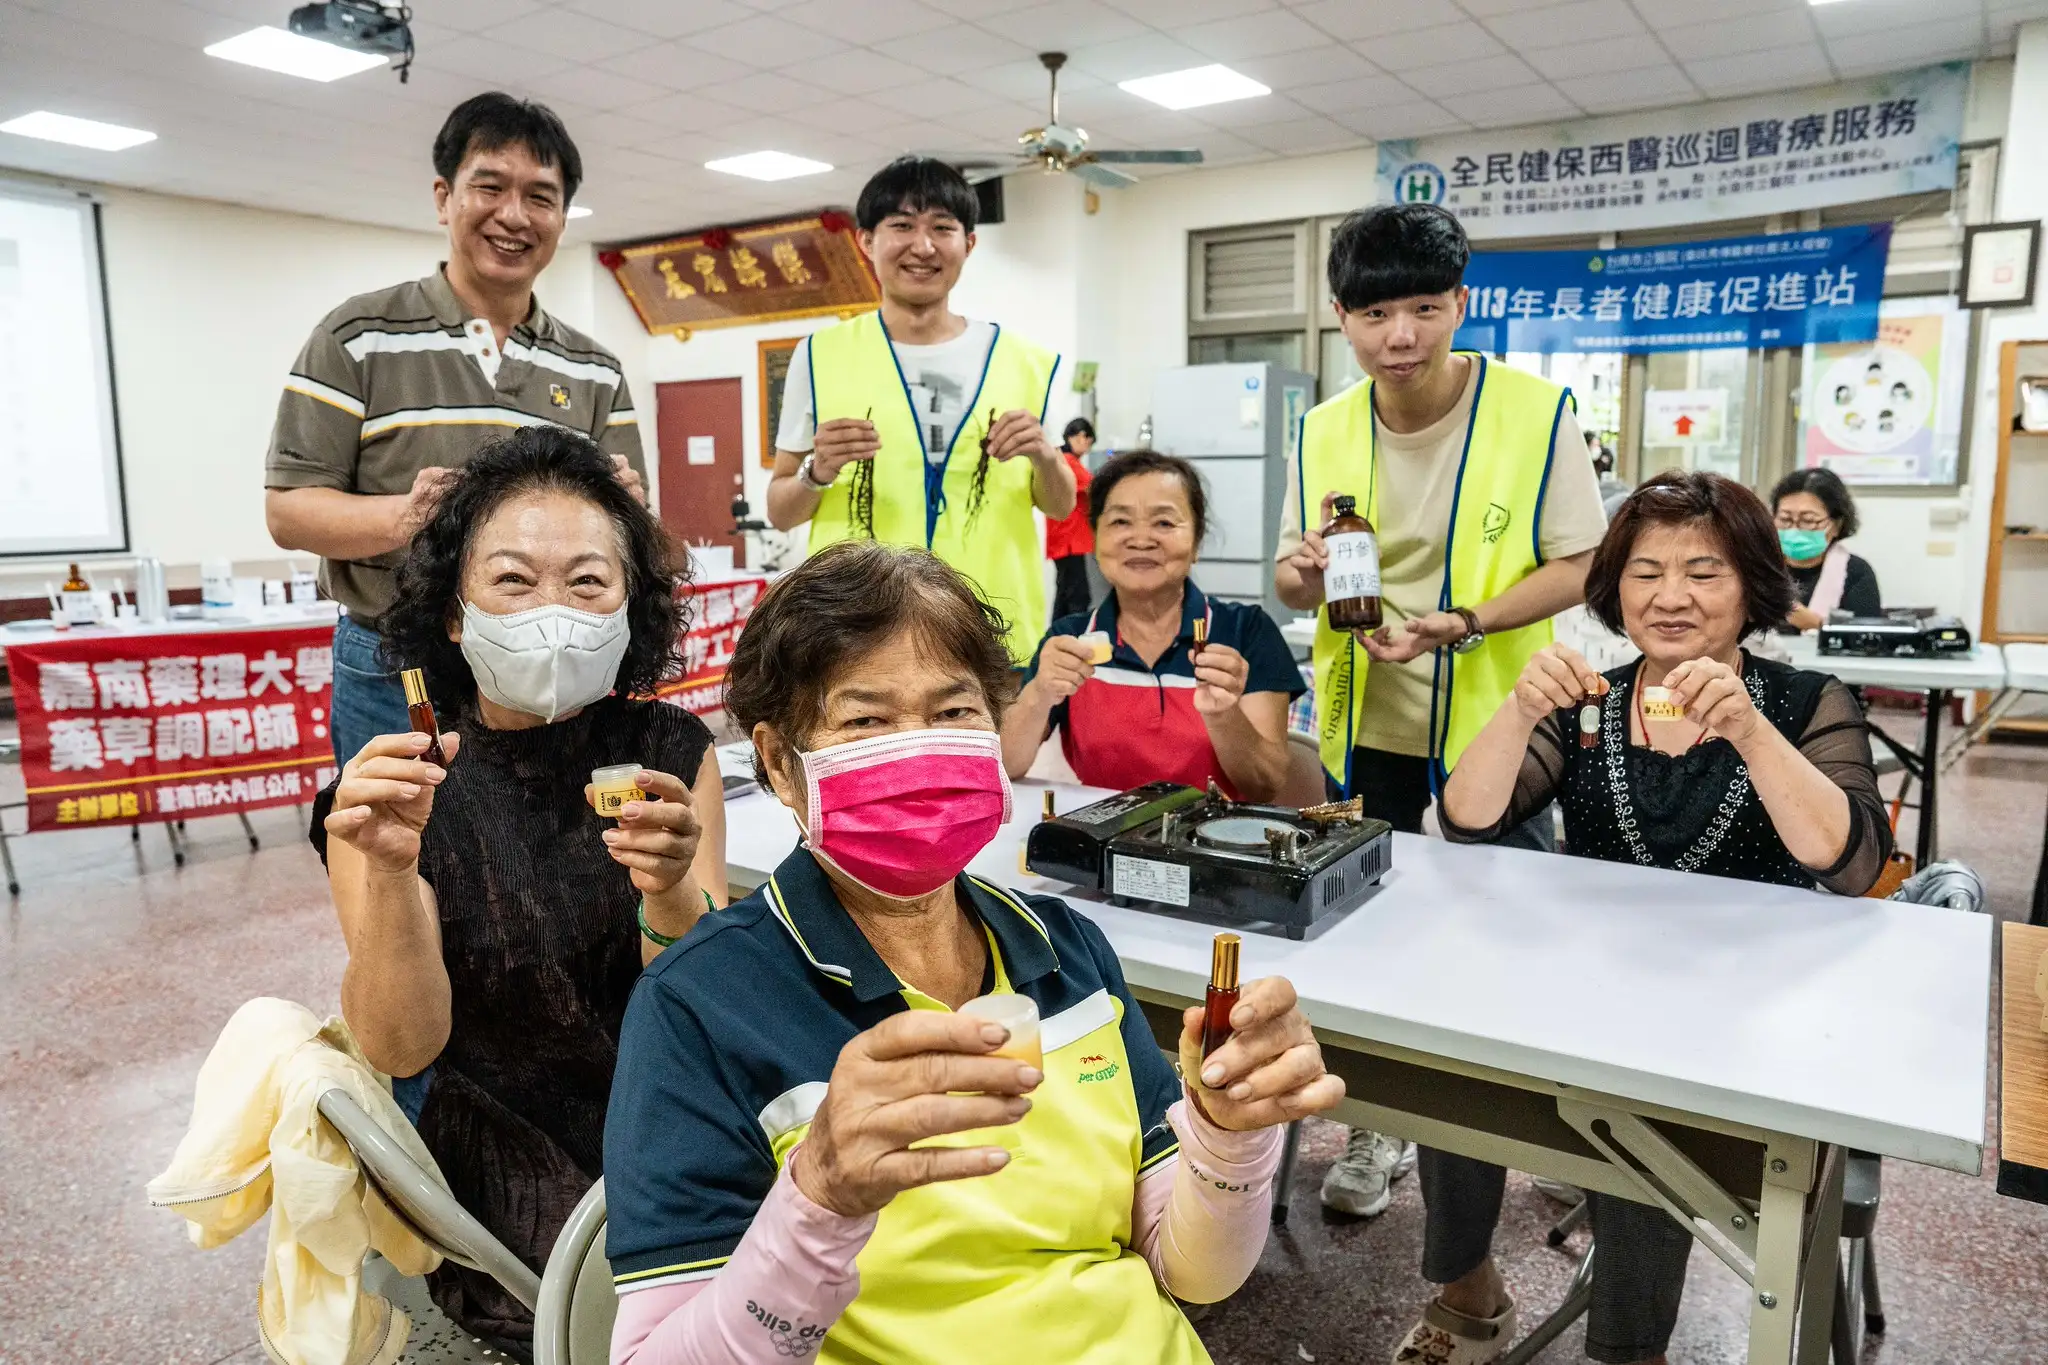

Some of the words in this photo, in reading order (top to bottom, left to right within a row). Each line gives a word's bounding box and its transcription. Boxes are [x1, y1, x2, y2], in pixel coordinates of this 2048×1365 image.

[1450, 98, 1918, 188] 全民健保西醫巡迴醫療服務
[1469, 263, 1858, 323] 113年長者健康促進站
[56, 792, 140, 823] 主辦單位
[746, 1299, 792, 1332] elite
